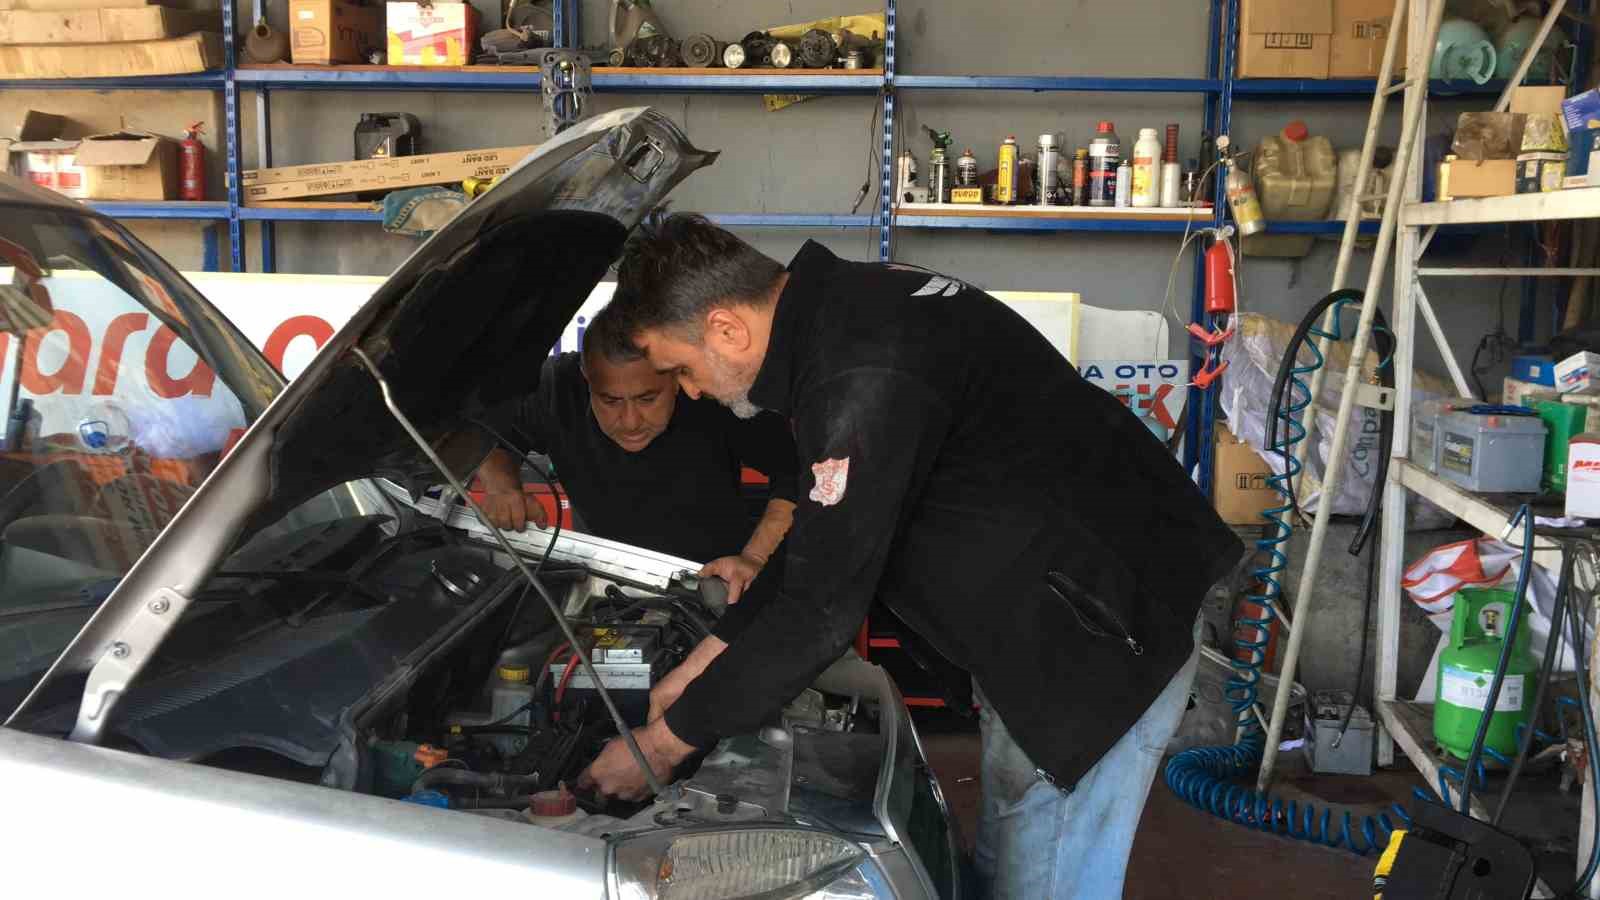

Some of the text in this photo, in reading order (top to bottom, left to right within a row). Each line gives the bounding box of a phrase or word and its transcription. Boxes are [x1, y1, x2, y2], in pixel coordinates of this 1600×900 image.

[0, 309, 217, 398] ara
[1076, 364, 1178, 379] A OTO
